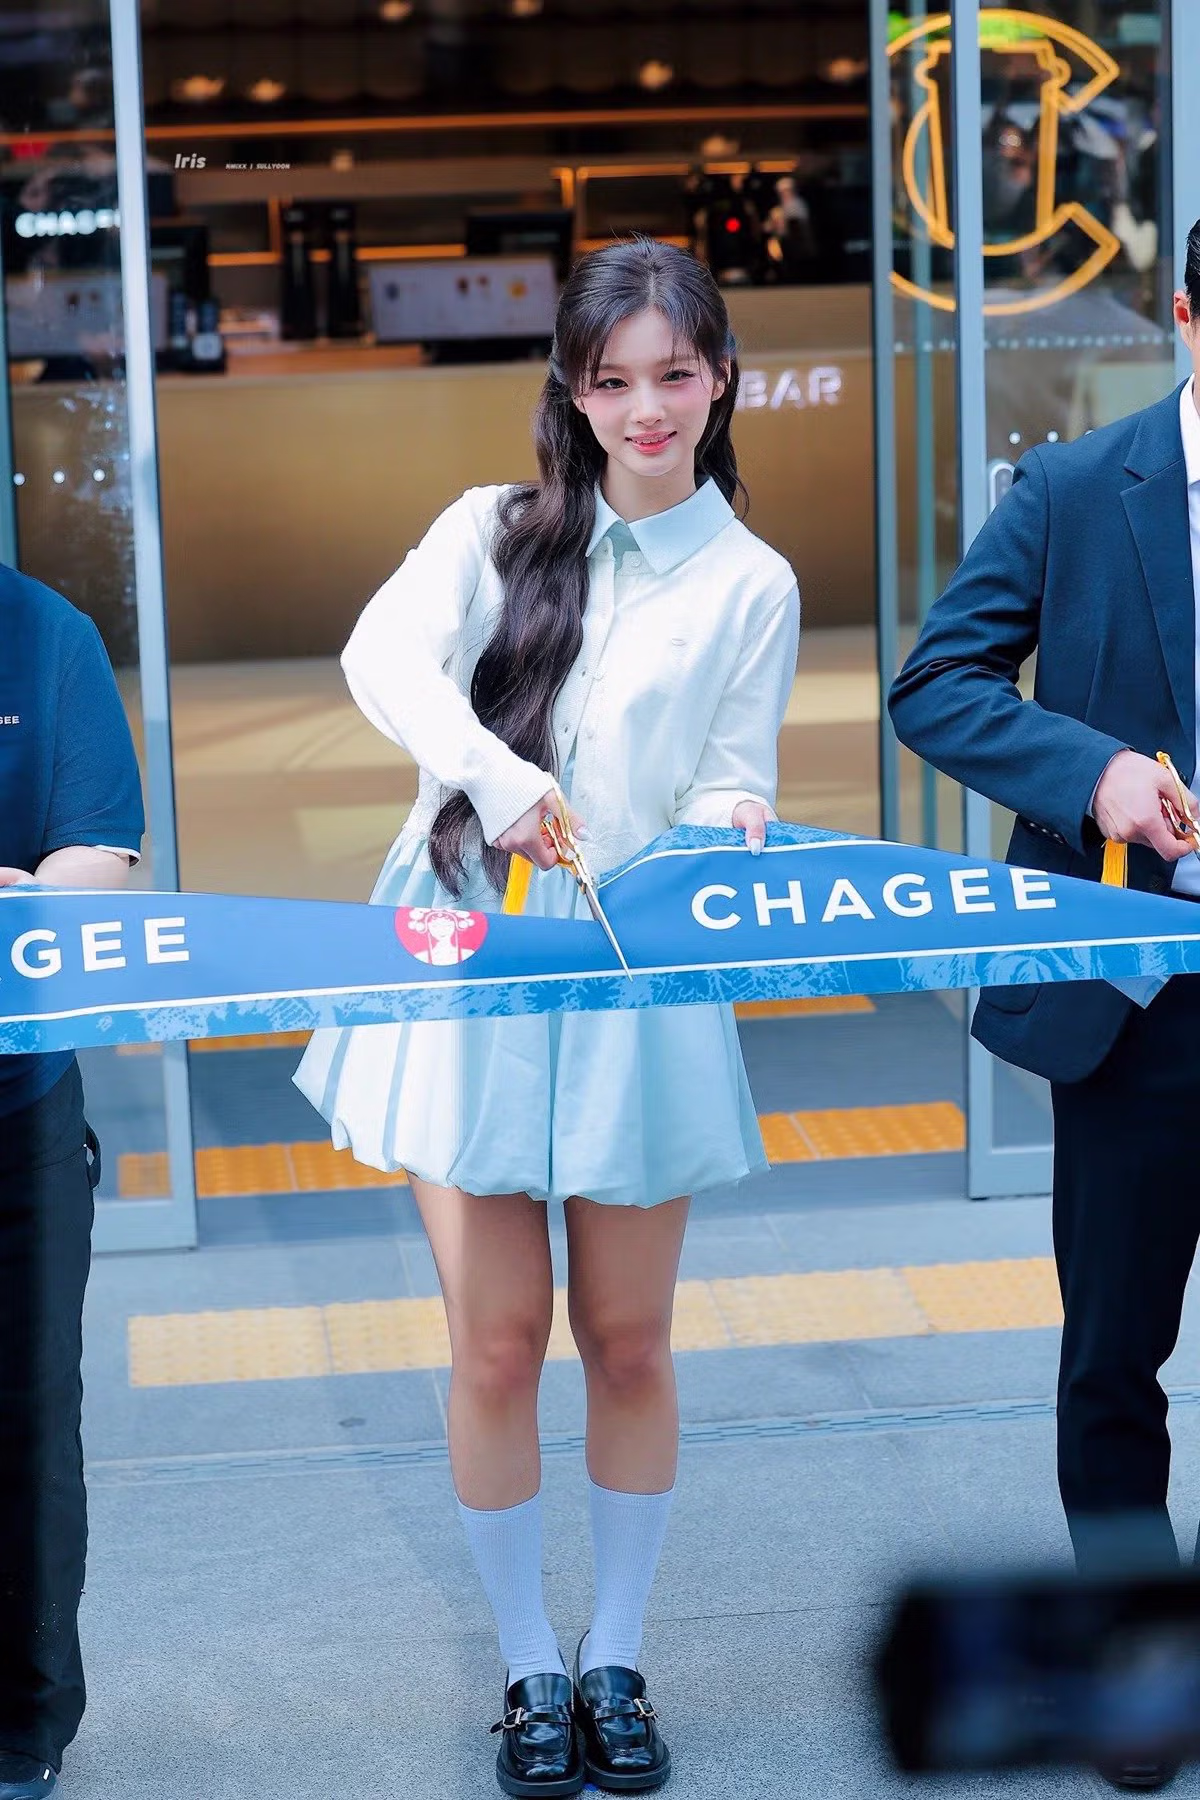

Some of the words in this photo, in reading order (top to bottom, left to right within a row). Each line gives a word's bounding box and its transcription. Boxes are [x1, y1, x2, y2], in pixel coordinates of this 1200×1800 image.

[735, 366, 843, 410] BAR
[690, 868, 1057, 931] CHAGEE
[0, 917, 190, 979] GEE
